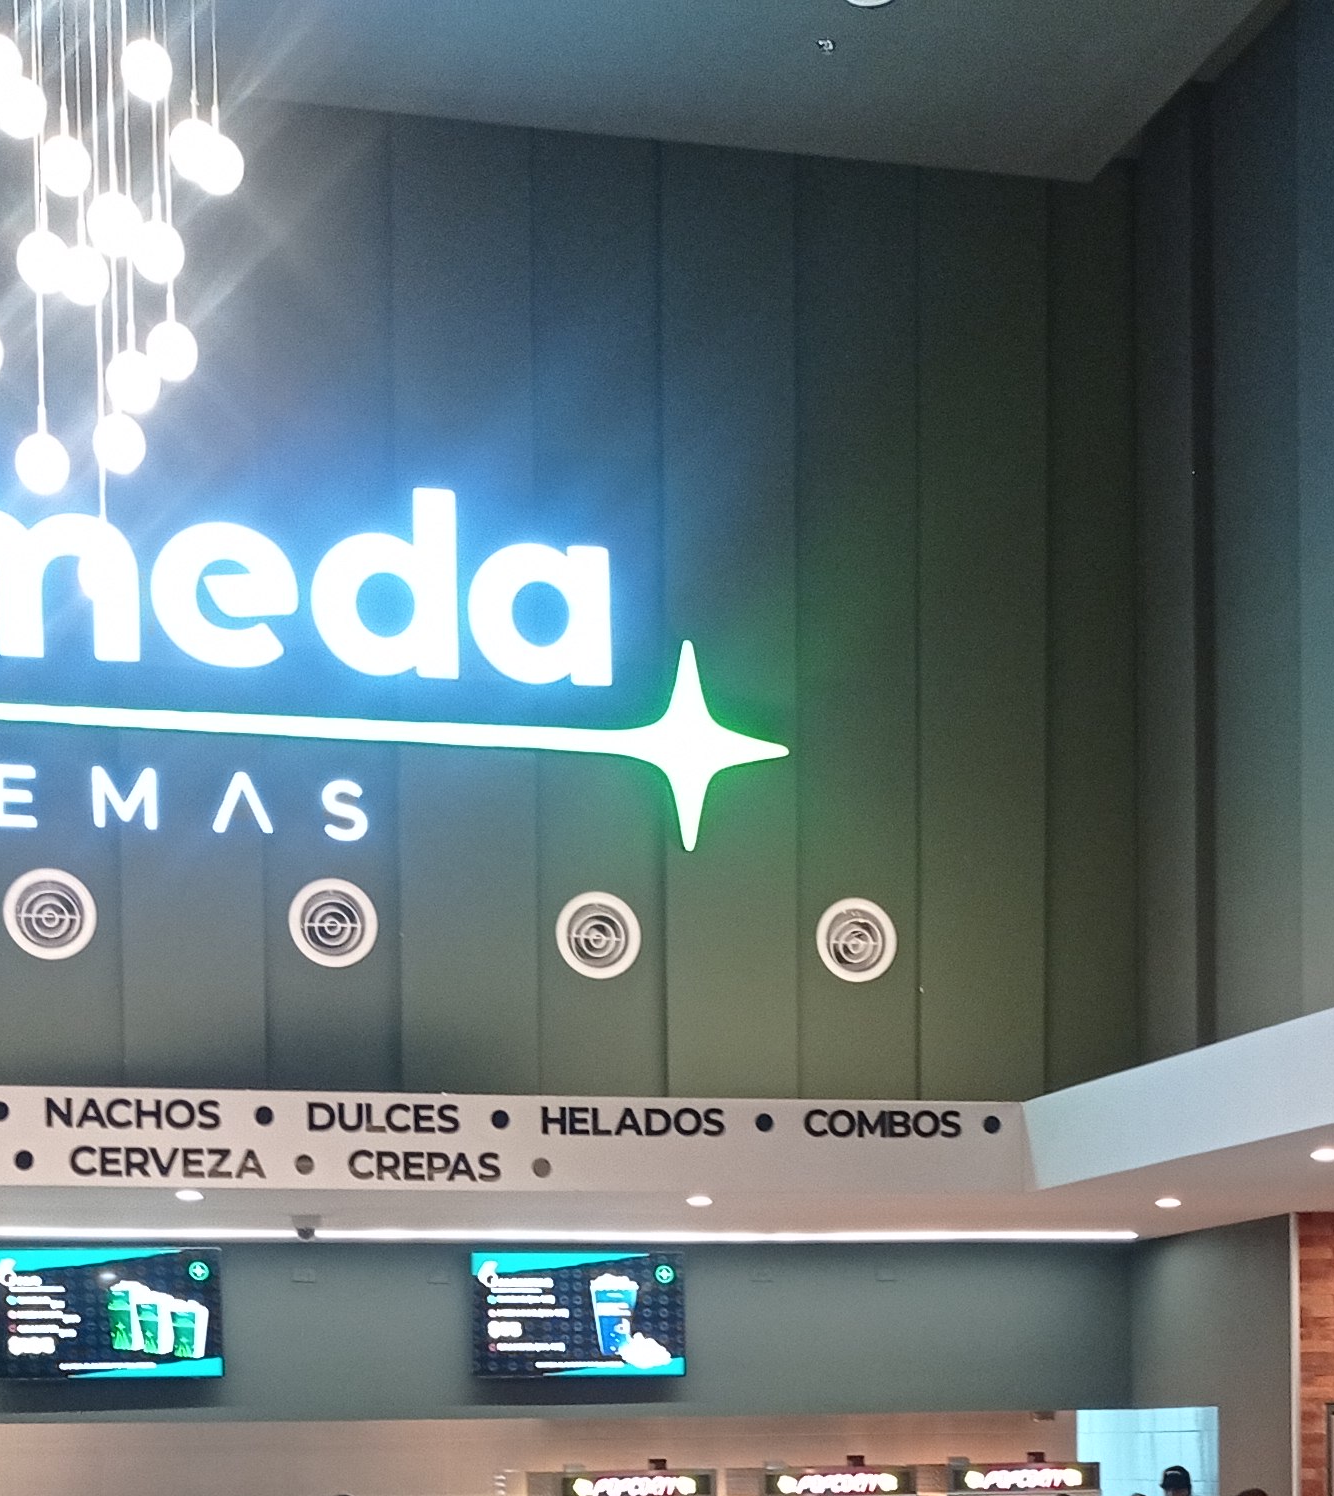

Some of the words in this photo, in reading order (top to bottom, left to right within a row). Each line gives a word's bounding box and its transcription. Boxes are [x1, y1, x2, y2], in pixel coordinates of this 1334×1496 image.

[44, 1096, 222, 1131] NACHOS
[306, 1100, 460, 1135] DULCES
[541, 1102, 727, 1138] HELADOS
[803, 1106, 963, 1140] COMBOS
[69, 1144, 267, 1180] CERVEZA
[347, 1149, 503, 1183] CREPAS
